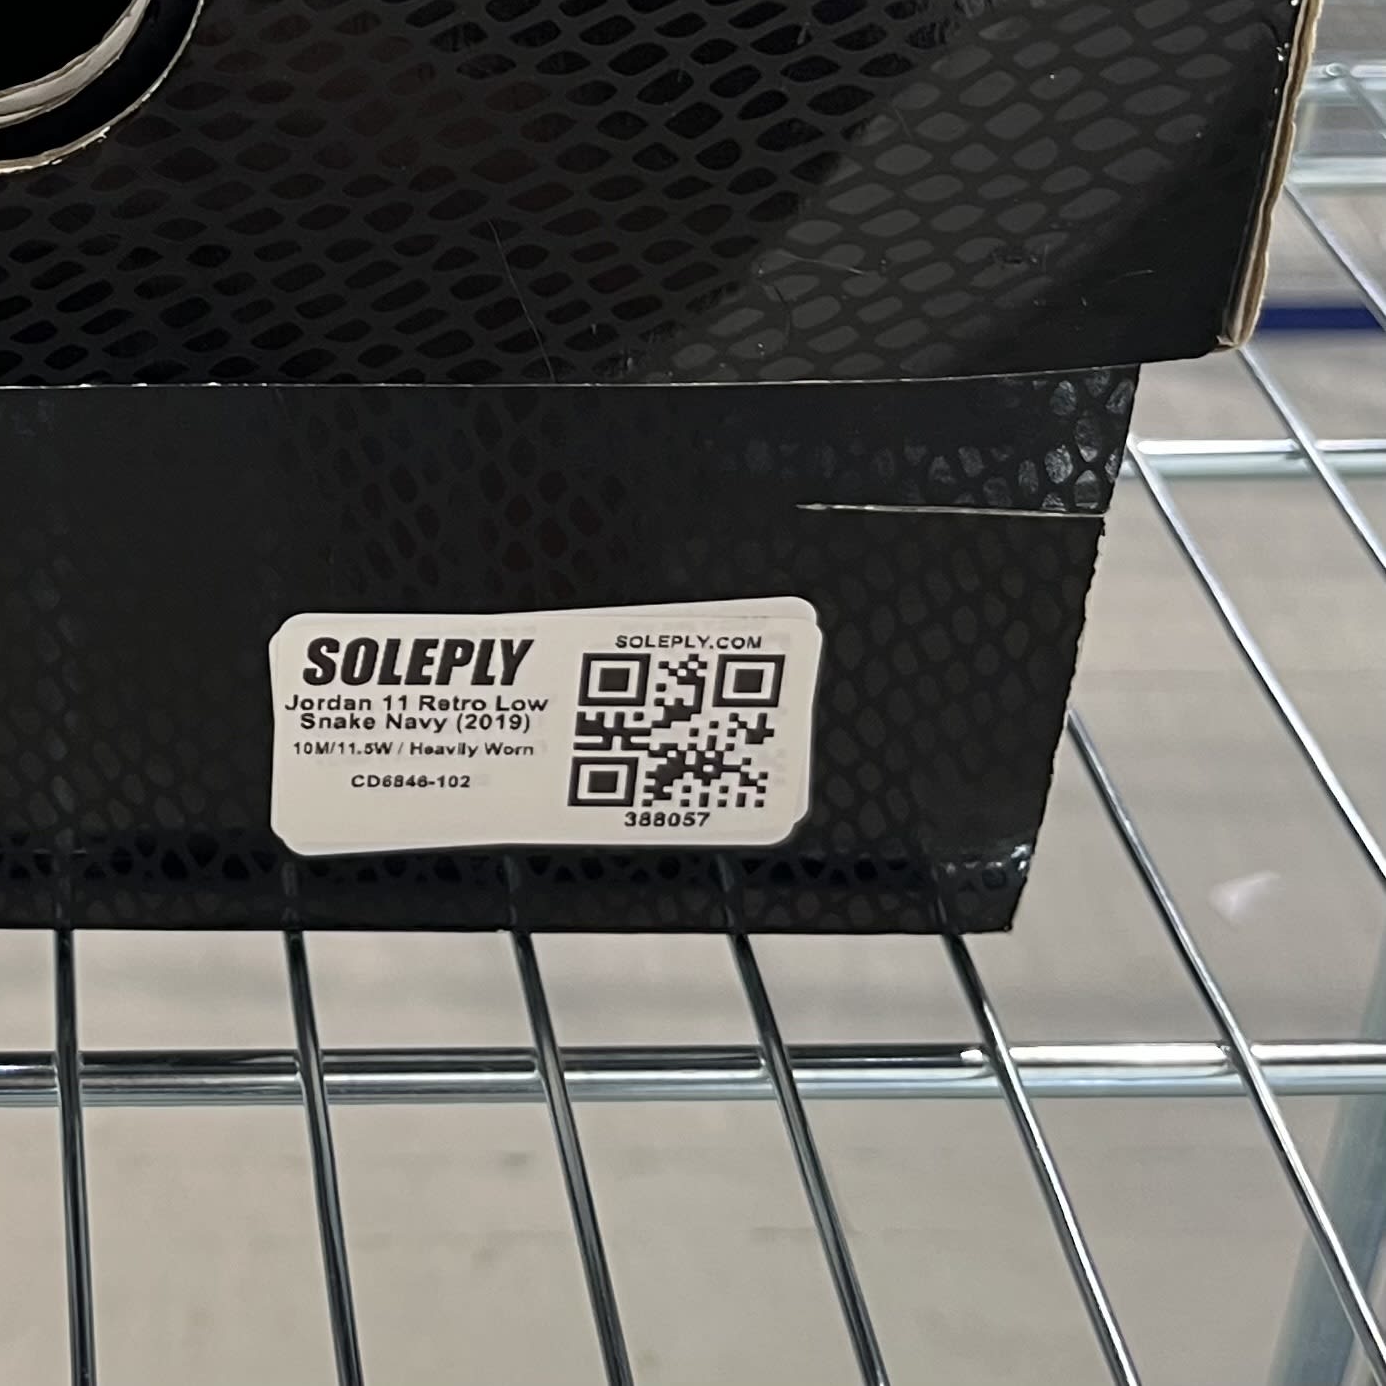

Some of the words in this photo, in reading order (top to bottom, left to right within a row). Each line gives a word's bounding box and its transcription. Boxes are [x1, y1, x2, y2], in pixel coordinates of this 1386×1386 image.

[614, 634, 763, 650] SOLEPLY.COM
[302, 637, 535, 686] SOLEPLY
[284, 694, 372, 712] Jordan
[382, 694, 409, 711] 11
[418, 695, 487, 712] Retro
[495, 695, 549, 712] Low
[300, 712, 376, 730] Snake
[385, 713, 447, 733] Navy
[456, 713, 531, 733] (2019)
[293, 741, 394, 756] 10M/11.5W
[409, 742, 479, 758] Heavily
[484, 742, 534, 756] Worn
[350, 774, 471, 789] CD6846-102
[624, 811, 710, 828] 388057
